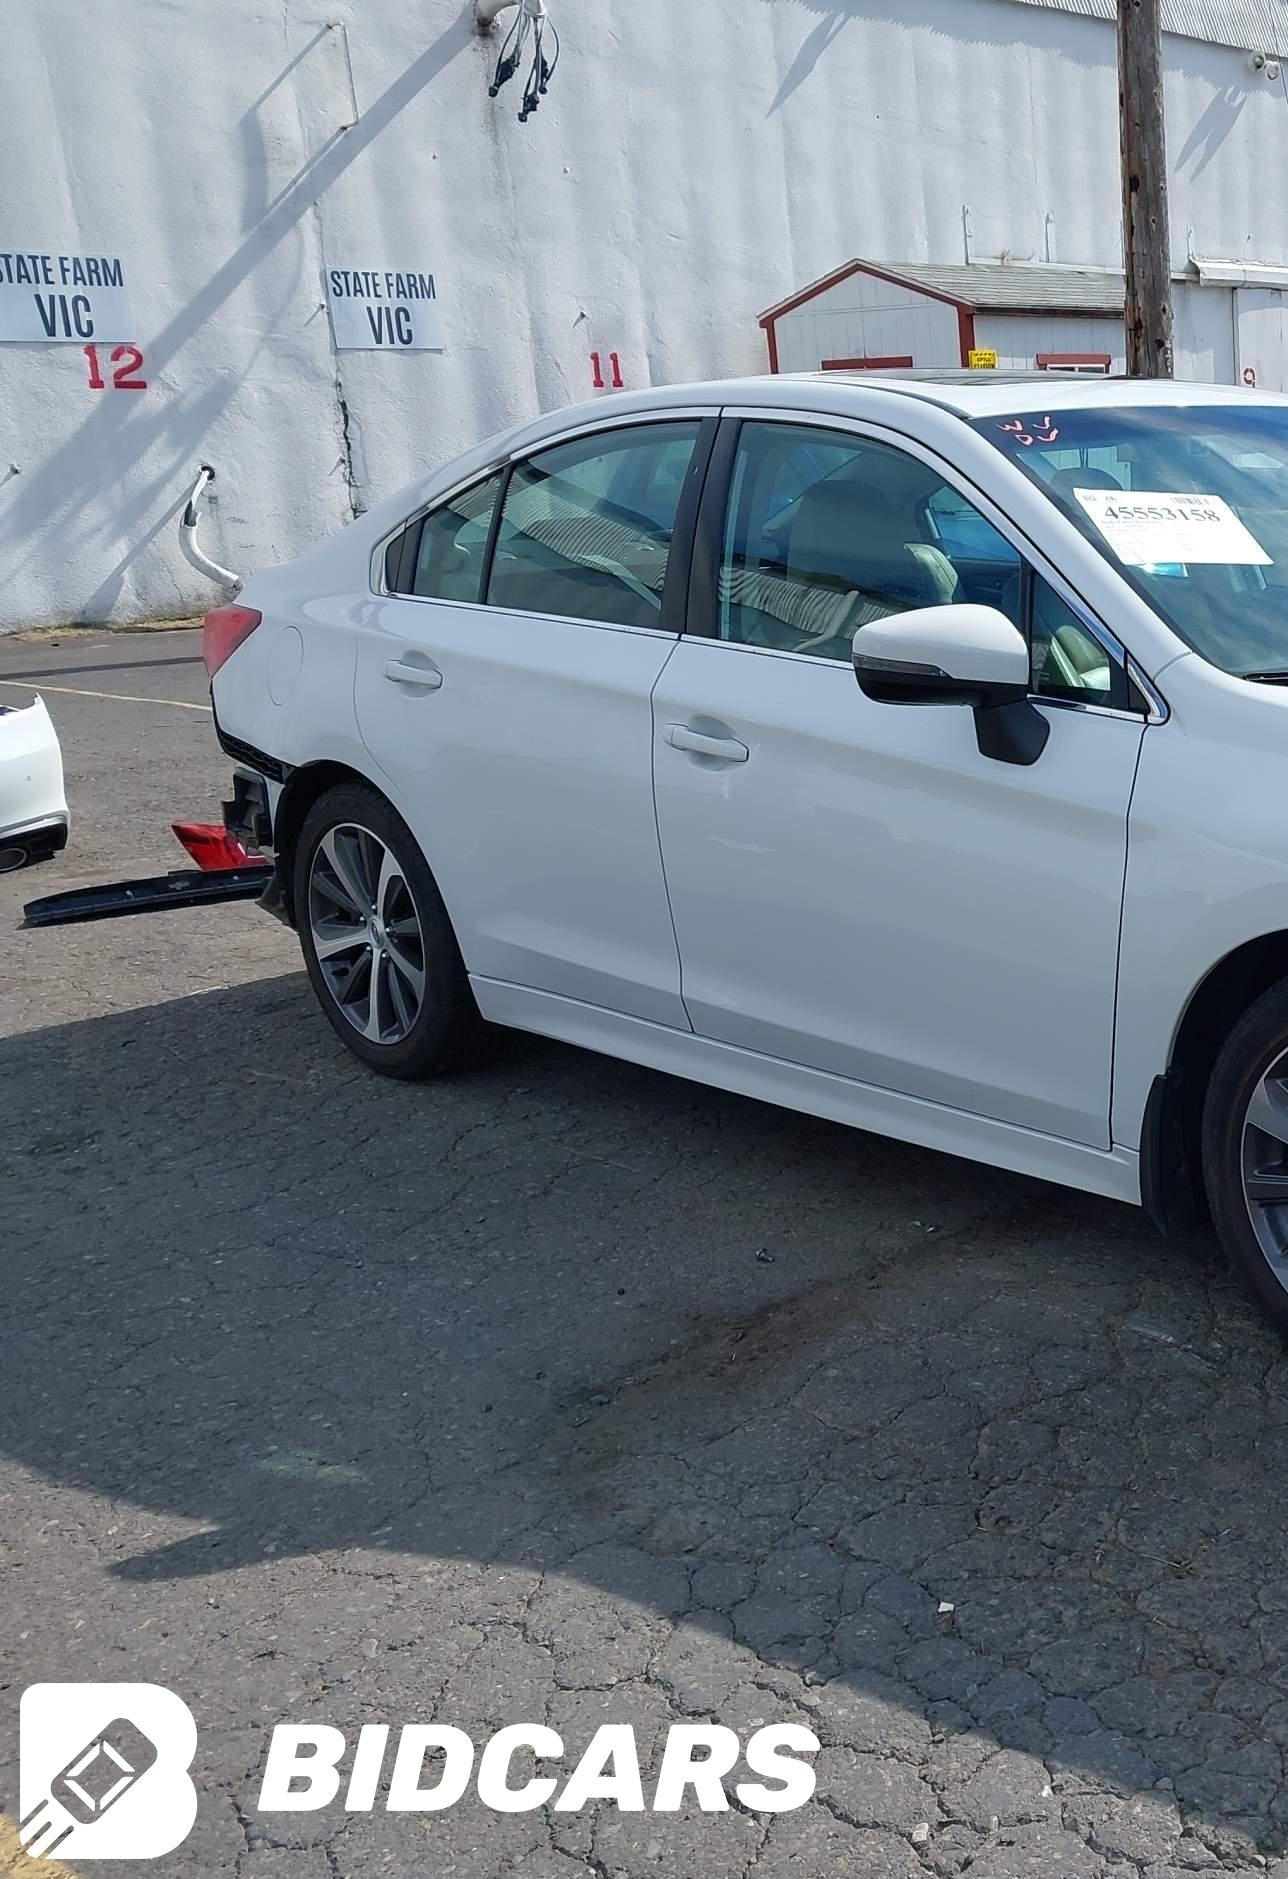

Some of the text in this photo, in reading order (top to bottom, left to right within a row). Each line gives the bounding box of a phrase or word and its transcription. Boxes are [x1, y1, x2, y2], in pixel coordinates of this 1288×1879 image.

[0, 253, 124, 287] TATE FARM
[330, 270, 436, 299] STATE FARM
[33, 293, 94, 338] VIC
[366, 306, 413, 345] VIC
[83, 345, 147, 389] 12
[590, 352, 624, 387] 11
[1243, 367, 1256, 388] 9
[1104, 506, 1221, 522] 45553158
